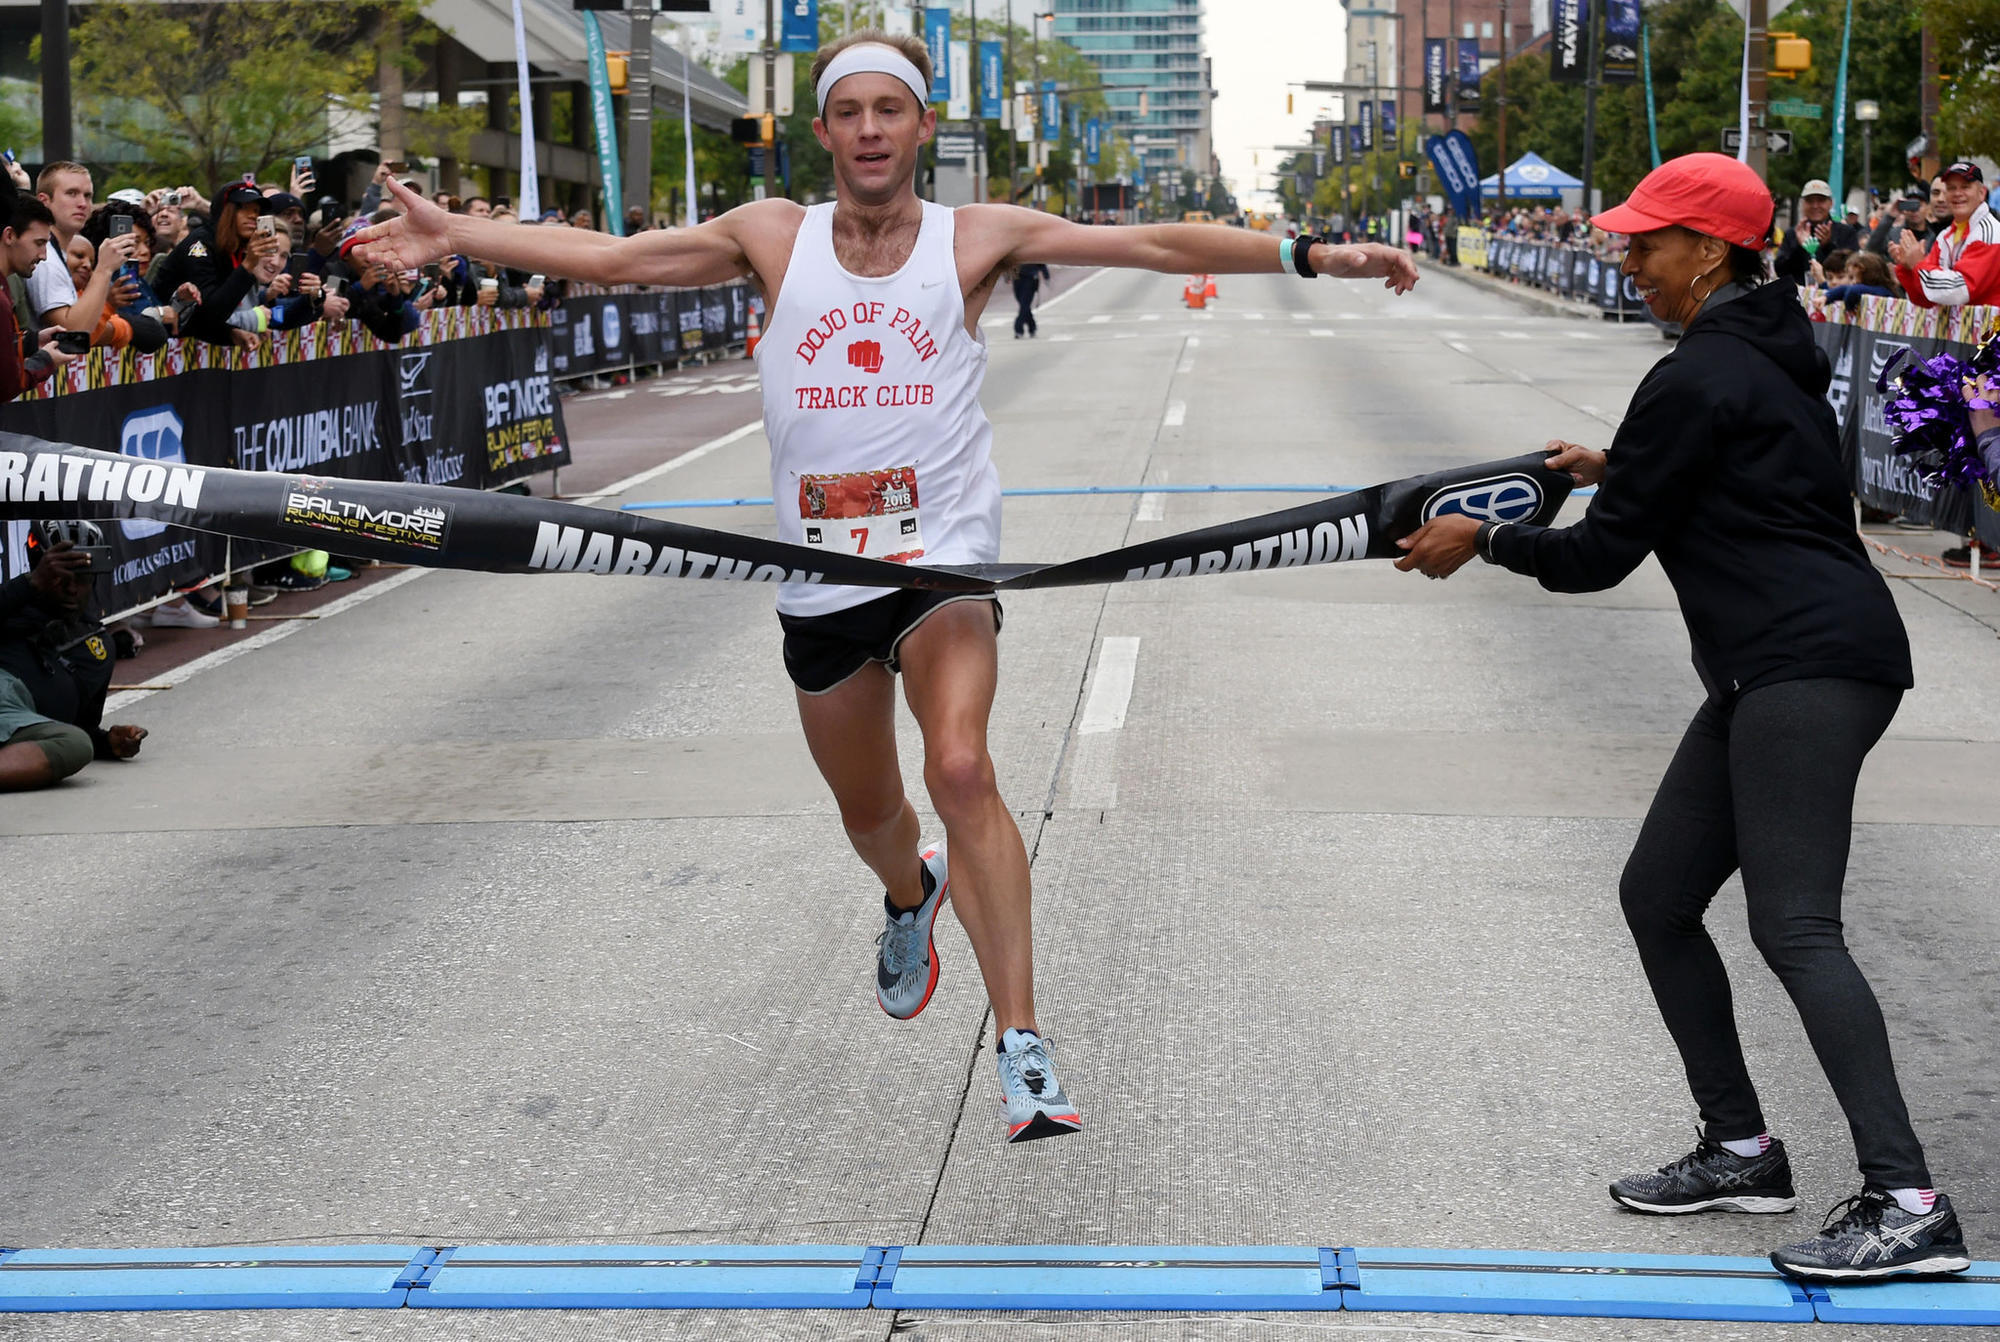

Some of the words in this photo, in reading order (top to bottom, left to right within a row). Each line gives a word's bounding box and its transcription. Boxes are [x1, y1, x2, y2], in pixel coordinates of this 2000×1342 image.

[935, 26, 946, 78] Baltimore
[1431, 45, 1441, 105] RAVENS
[1446, 136, 1478, 189] GEICO
[796, 308, 847, 365] DOJO
[853, 302, 885, 323] OF
[888, 307, 938, 362] PAIN
[795, 386, 868, 409] TRACK
[876, 384, 934, 406] CLUB
[342, 400, 381, 457] BANK
[288, 493, 444, 537] BALTIMORE
[882, 493, 912, 508] 2018
[285, 507, 360, 529] RUNNING
[364, 521, 442, 545] FESTIVAL
[850, 527, 869, 554] 7
